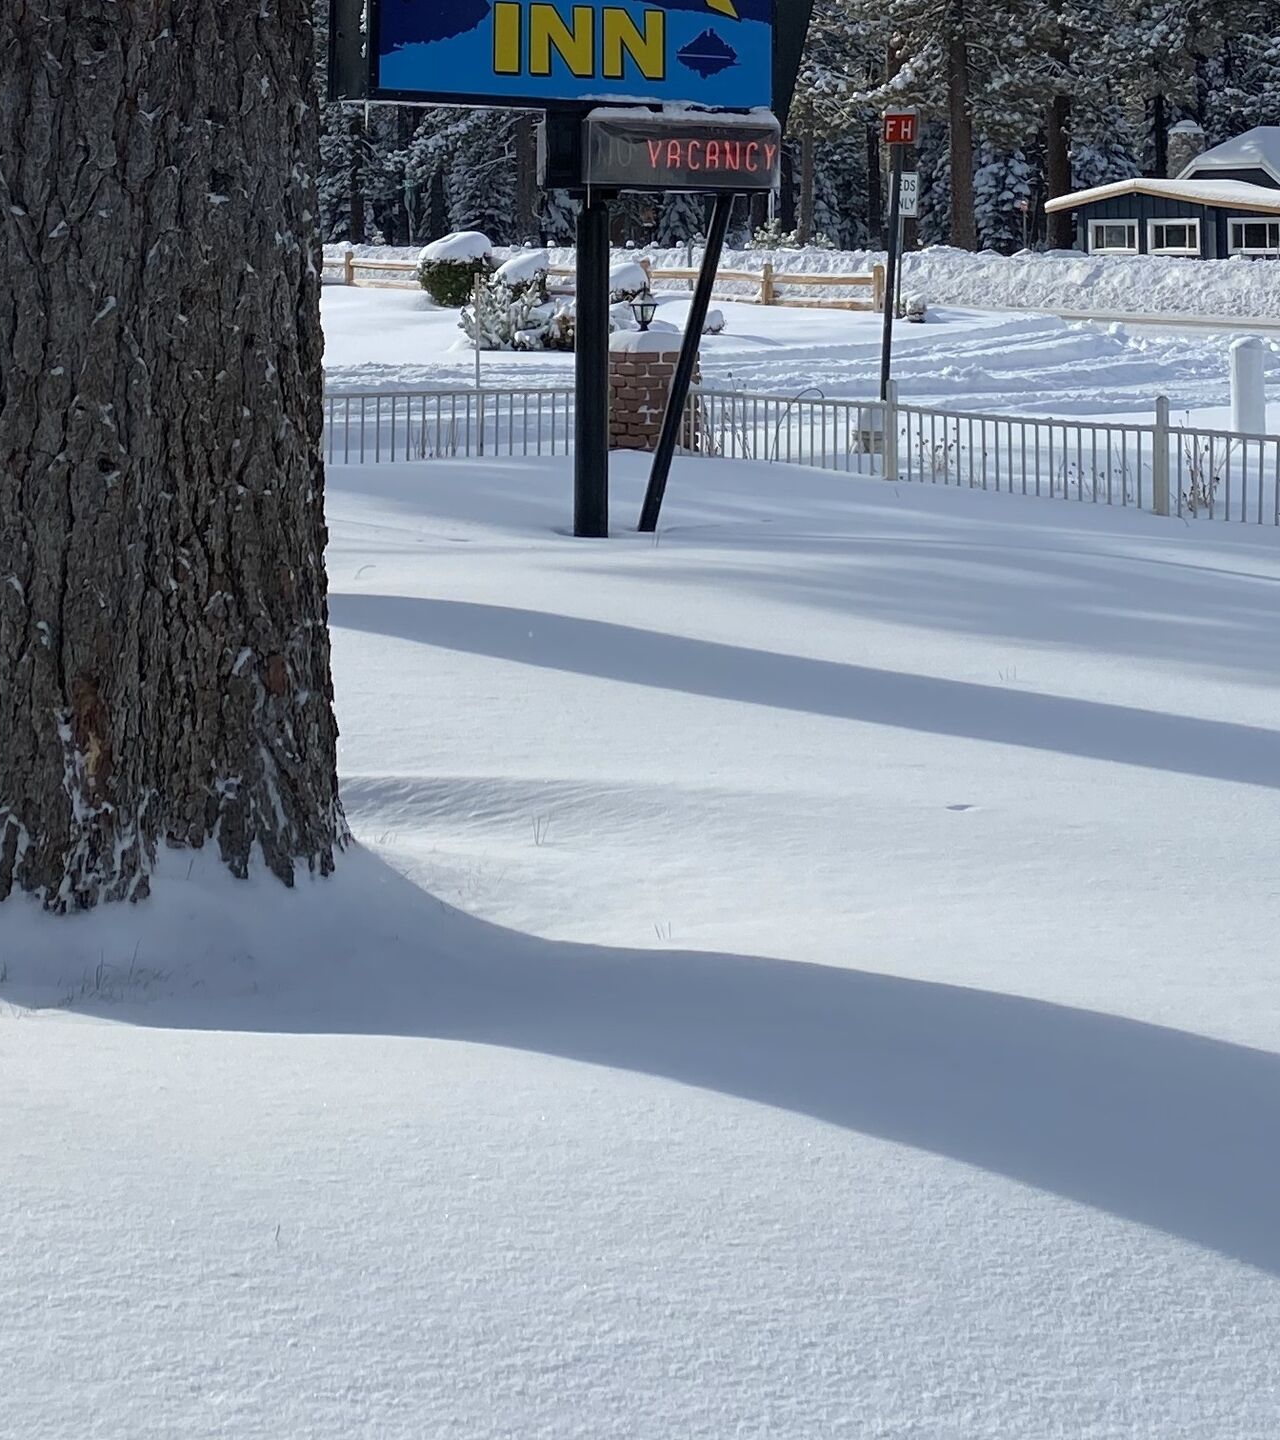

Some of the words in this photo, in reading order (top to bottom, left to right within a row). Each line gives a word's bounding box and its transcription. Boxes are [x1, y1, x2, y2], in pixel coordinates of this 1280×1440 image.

[493, 1, 666, 80] INN
[647, 139, 777, 172] VACANCY
[900, 179, 916, 192] EDS
[899, 197, 916, 211] NLY
